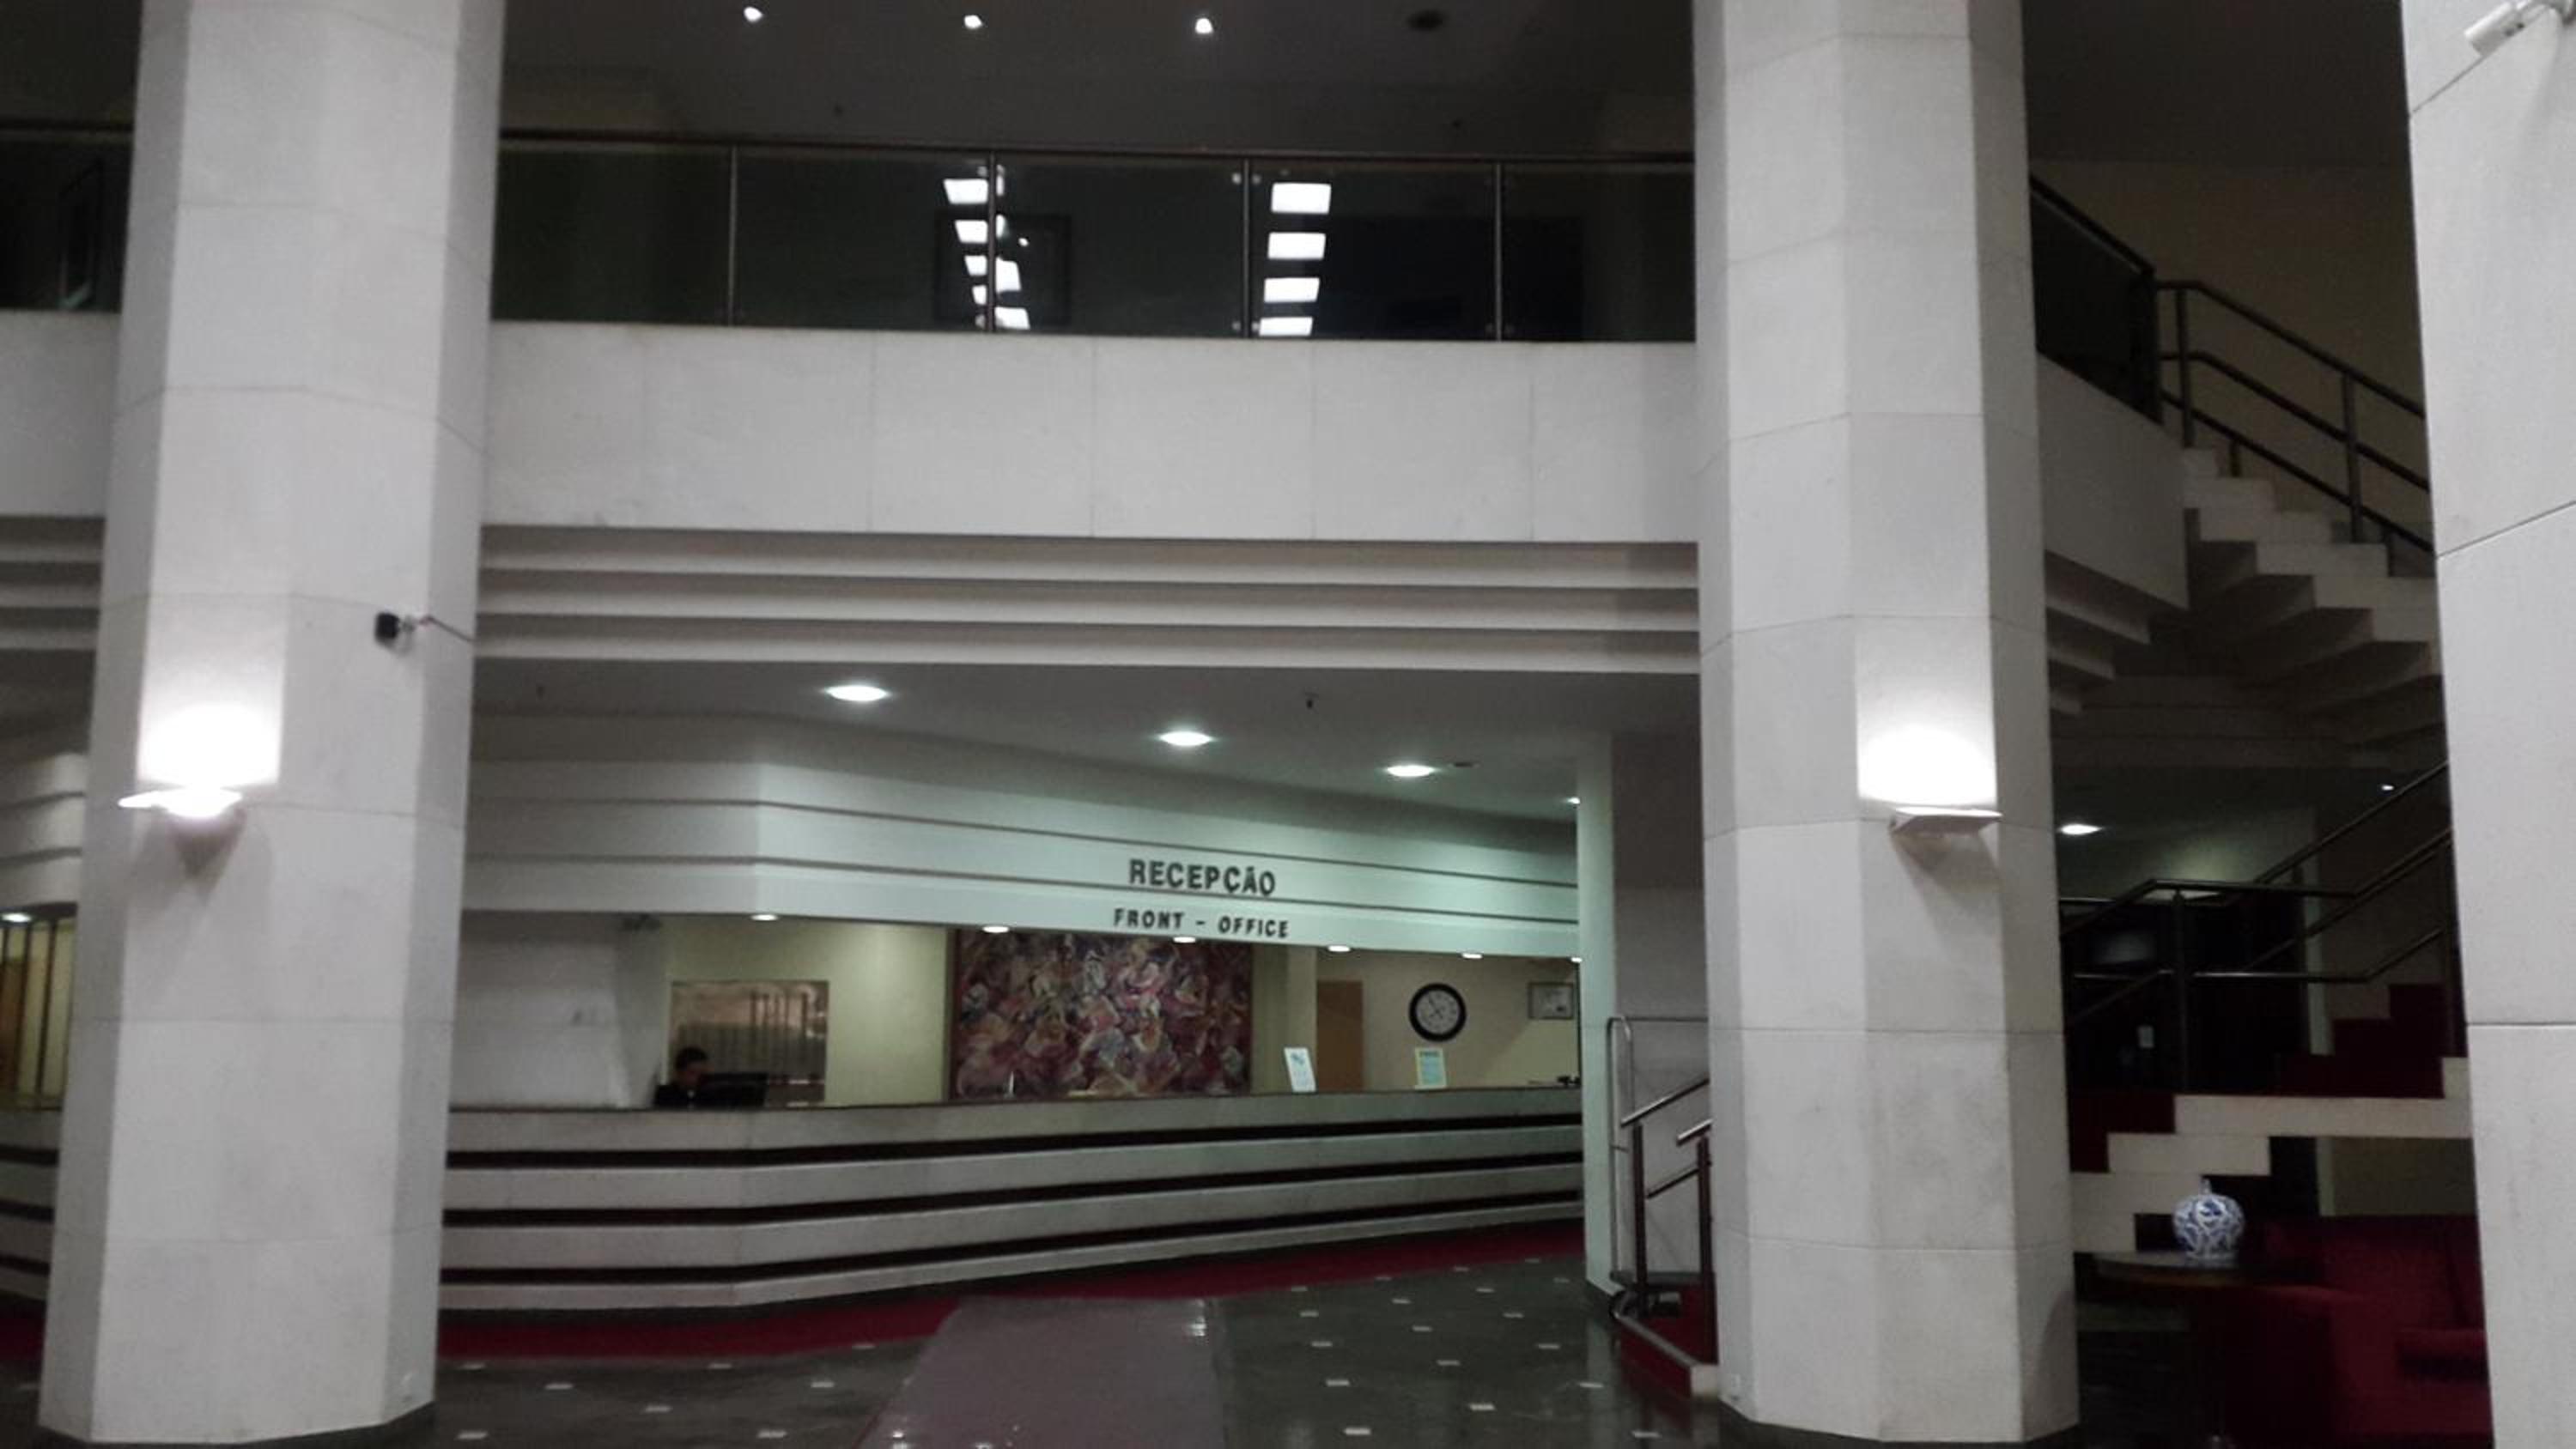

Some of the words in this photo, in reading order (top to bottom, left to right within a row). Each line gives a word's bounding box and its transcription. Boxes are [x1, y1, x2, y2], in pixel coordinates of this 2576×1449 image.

[1130, 860, 1275, 895] RECEPÇÃO
[1115, 909, 1184, 928] FRONT
[1218, 917, 1289, 938] OFFICE
